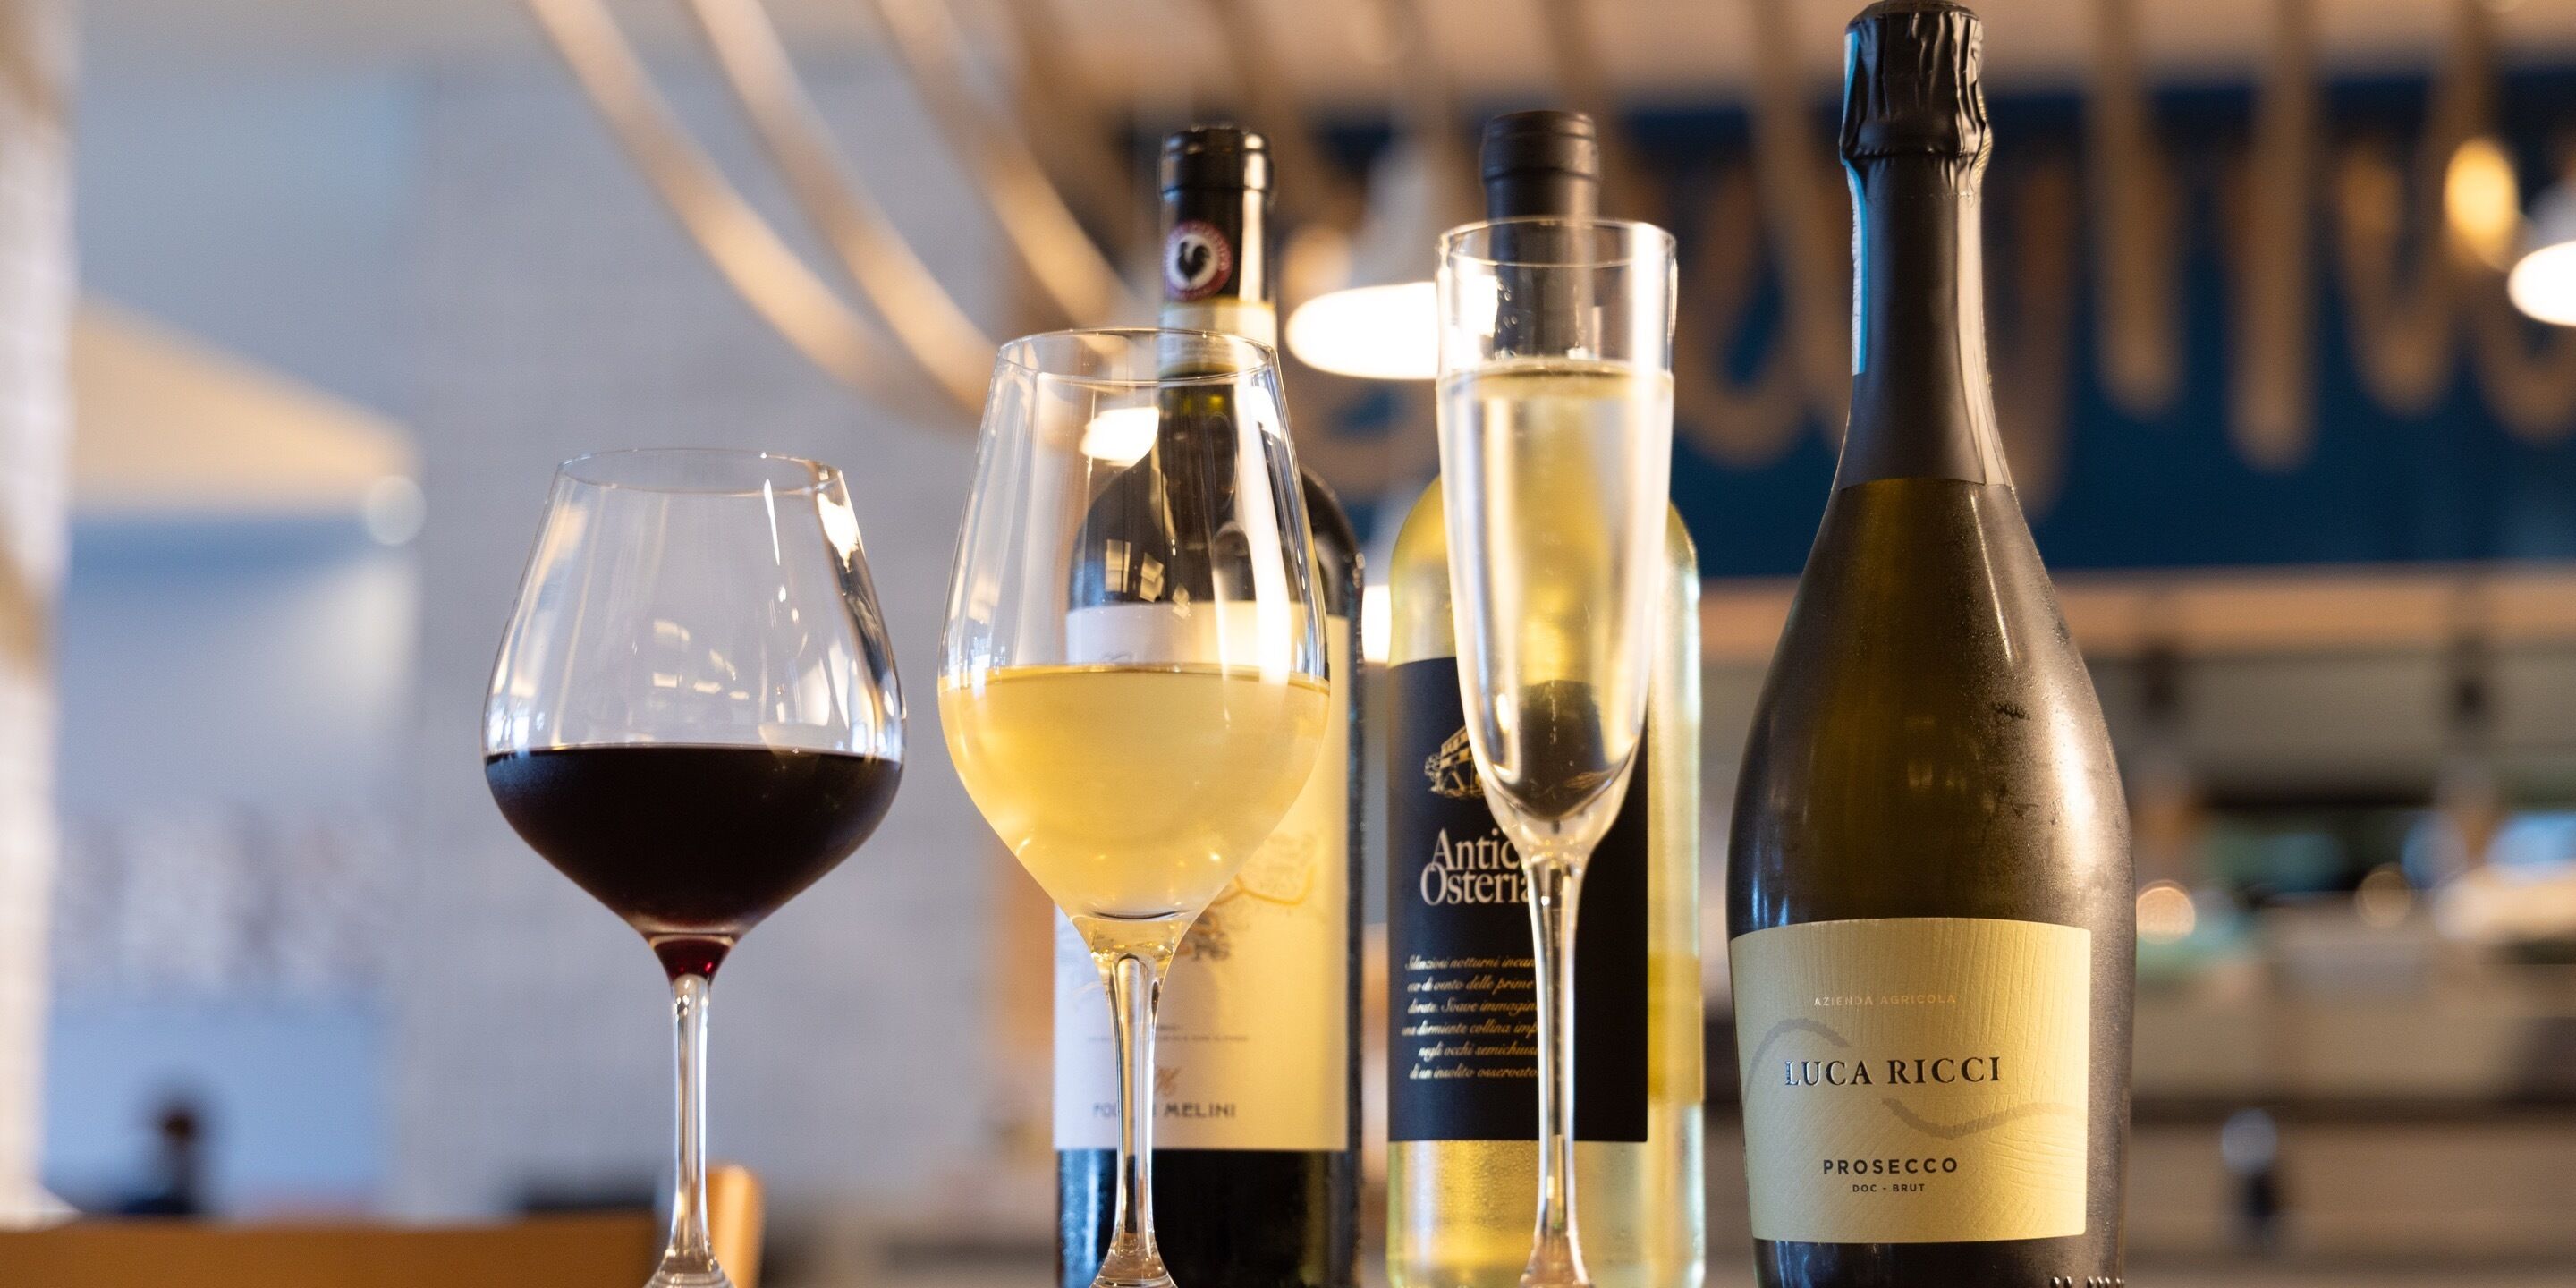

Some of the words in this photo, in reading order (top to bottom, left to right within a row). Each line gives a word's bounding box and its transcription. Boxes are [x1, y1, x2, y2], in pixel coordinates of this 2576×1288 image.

[1429, 828, 1521, 871] Antic
[1501, 955, 1536, 968] incan
[1813, 996, 1874, 1006] AZIENDA
[1880, 994, 1956, 1005] AGRICOLA
[1479, 1000, 1538, 1017] immagin
[1513, 1021, 1538, 1039] imp
[1477, 1067, 1538, 1079] osservato
[1784, 1060, 1874, 1086] LUCA
[1886, 1056, 2001, 1085] RICCI
[1164, 1102, 1237, 1117] MELINI
[1823, 1157, 1958, 1174] PROSECCO
[1852, 1183, 1877, 1192] DOC
[1892, 1182, 1926, 1192] BRUT
